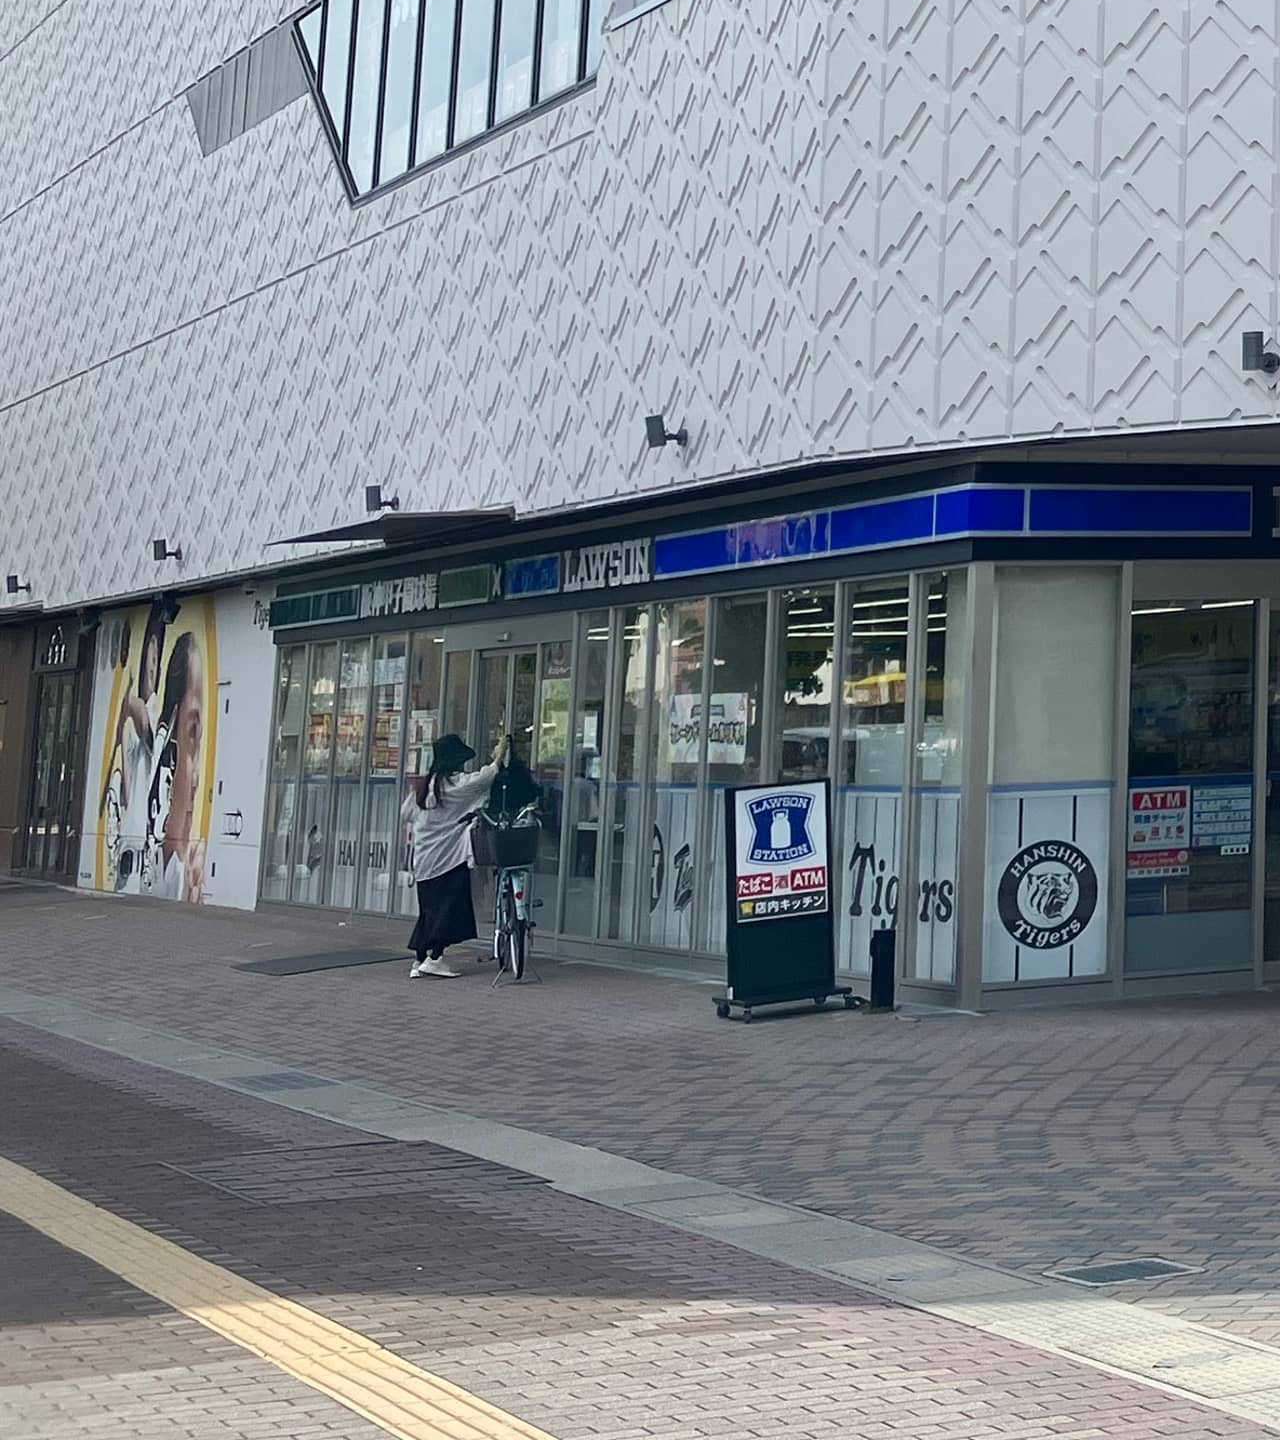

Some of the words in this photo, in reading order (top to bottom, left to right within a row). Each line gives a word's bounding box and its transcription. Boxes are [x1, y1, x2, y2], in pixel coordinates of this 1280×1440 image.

[563, 537, 652, 593] LAWSON
[751, 794, 808, 814] LAWSON
[1139, 792, 1182, 809] ATM
[753, 843, 809, 861] STATION
[1010, 844, 1087, 878] HANSHIN
[738, 877, 774, 896] たばこ
[793, 870, 824, 888] ATM
[850, 842, 953, 930] Tigrs
[755, 895, 824, 915] 店内キッチン
[1013, 919, 1081, 948] Tigers
